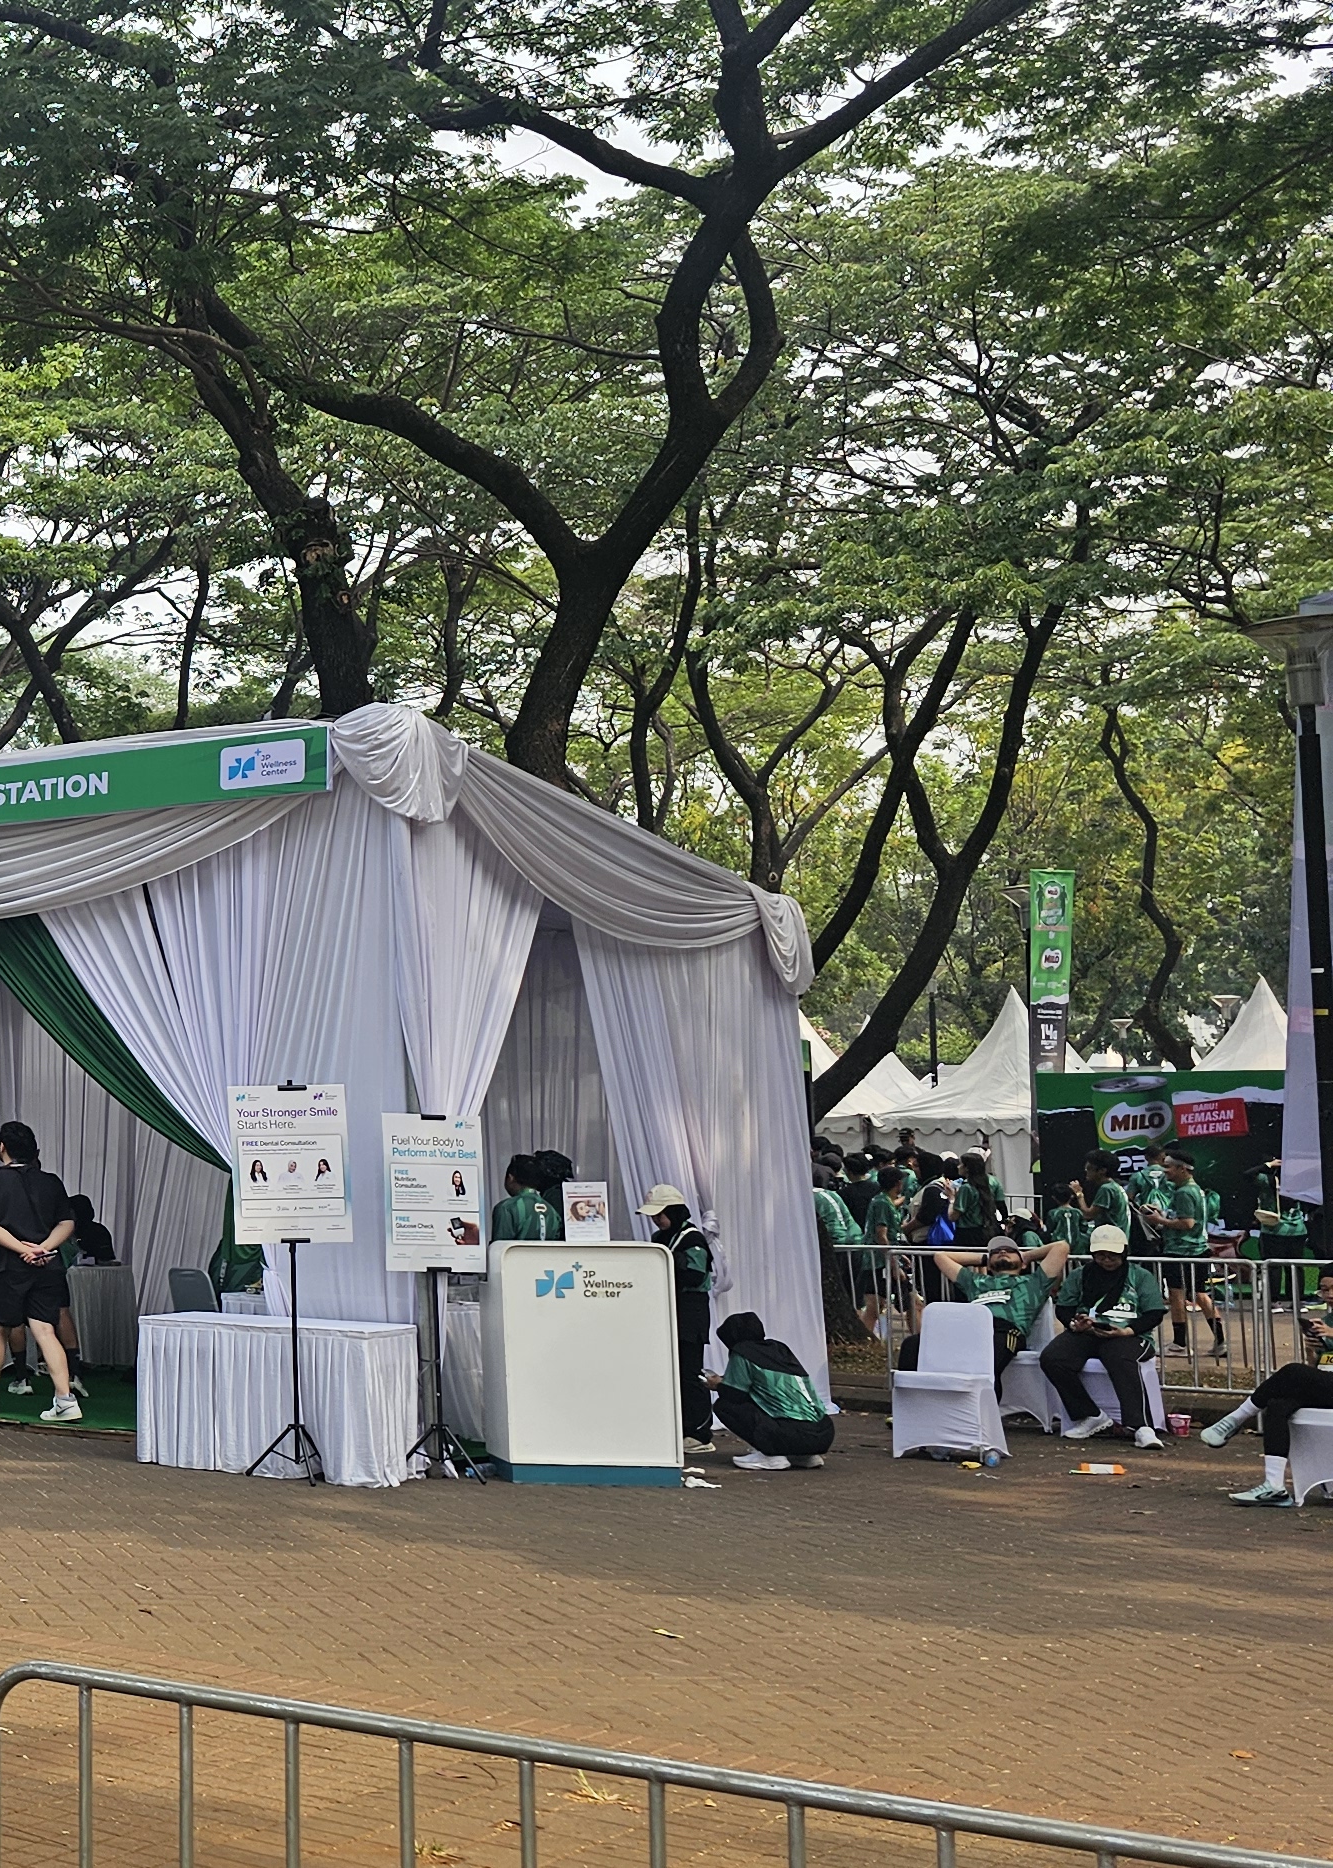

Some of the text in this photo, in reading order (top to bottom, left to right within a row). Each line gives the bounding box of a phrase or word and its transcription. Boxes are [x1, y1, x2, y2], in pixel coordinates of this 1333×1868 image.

[261, 759, 297, 769] Wellness
[261, 768, 288, 777] Center
[236, 1106, 338, 1118] Your Stronger Smile
[1180, 1109, 1234, 1125] KEMASAN
[237, 1120, 296, 1129] Starts Here.
[1110, 1112, 1166, 1132] MILO
[1187, 1122, 1231, 1136] KALENG
[391, 1135, 464, 1148] Fuel Your Body to
[392, 1147, 476, 1158] Perform at Your Best
[1117, 1155, 1149, 1172] PR
[582, 1270, 596, 1279] JP
[582, 1279, 633, 1289] Wellness
[583, 1289, 621, 1298] Ceter
